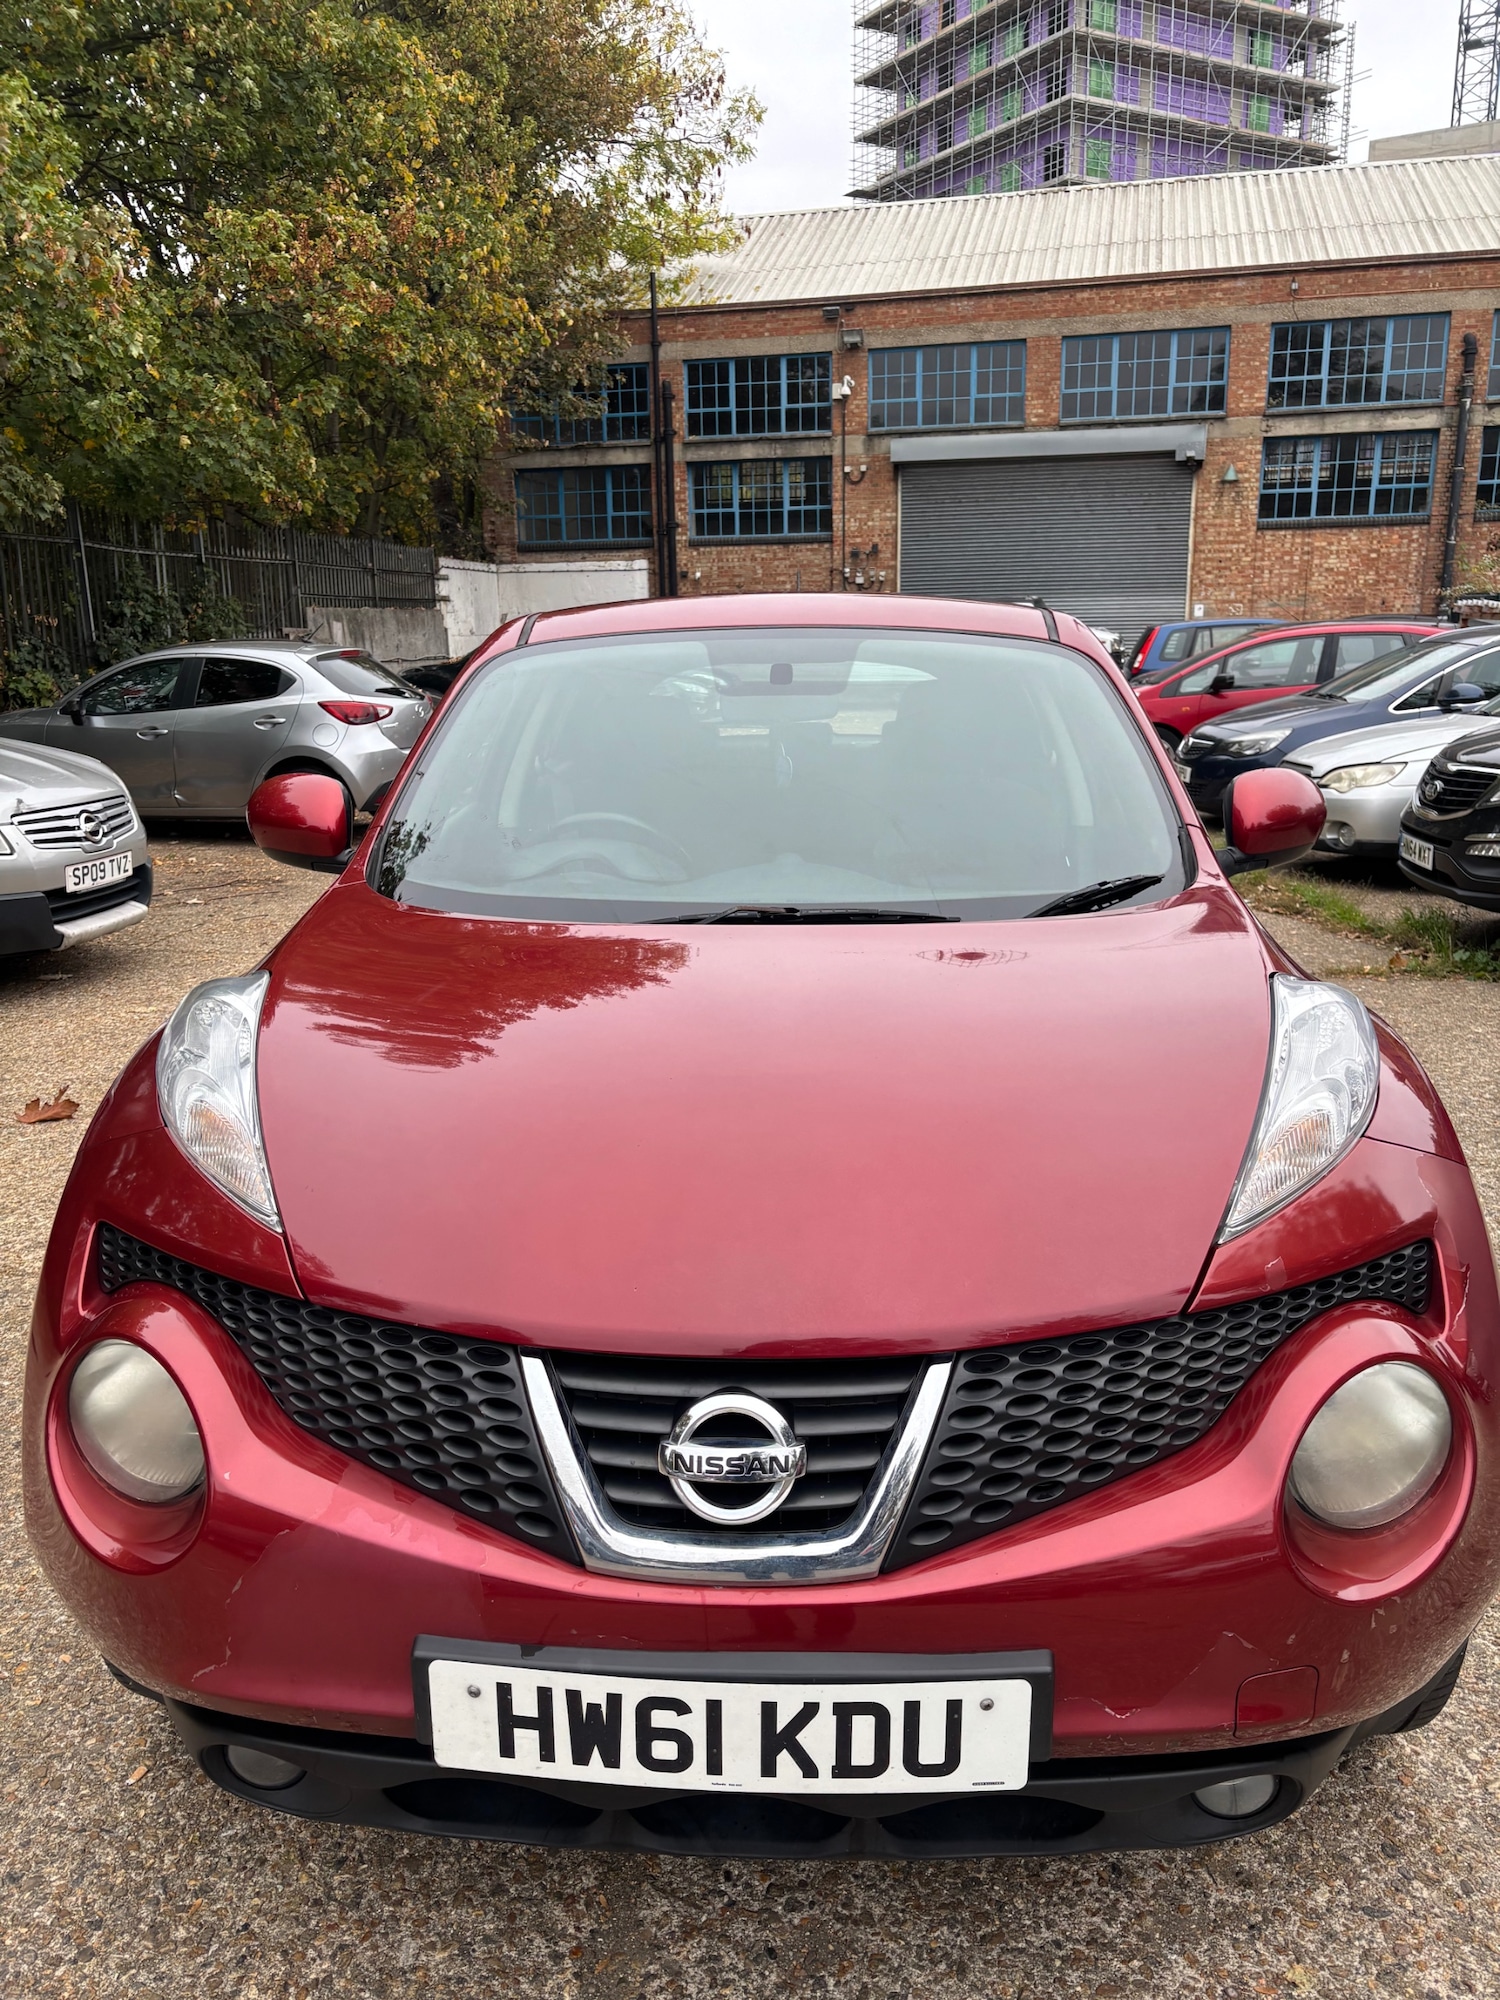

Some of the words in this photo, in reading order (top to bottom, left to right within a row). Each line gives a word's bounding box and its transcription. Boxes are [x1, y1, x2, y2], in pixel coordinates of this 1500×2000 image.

[72, 861, 106, 886] SP09
[109, 855, 128, 877] TVZ
[672, 1453, 790, 1476] NISSAN
[495, 1682, 723, 1776] HW61
[760, 1699, 963, 1779] KDU
